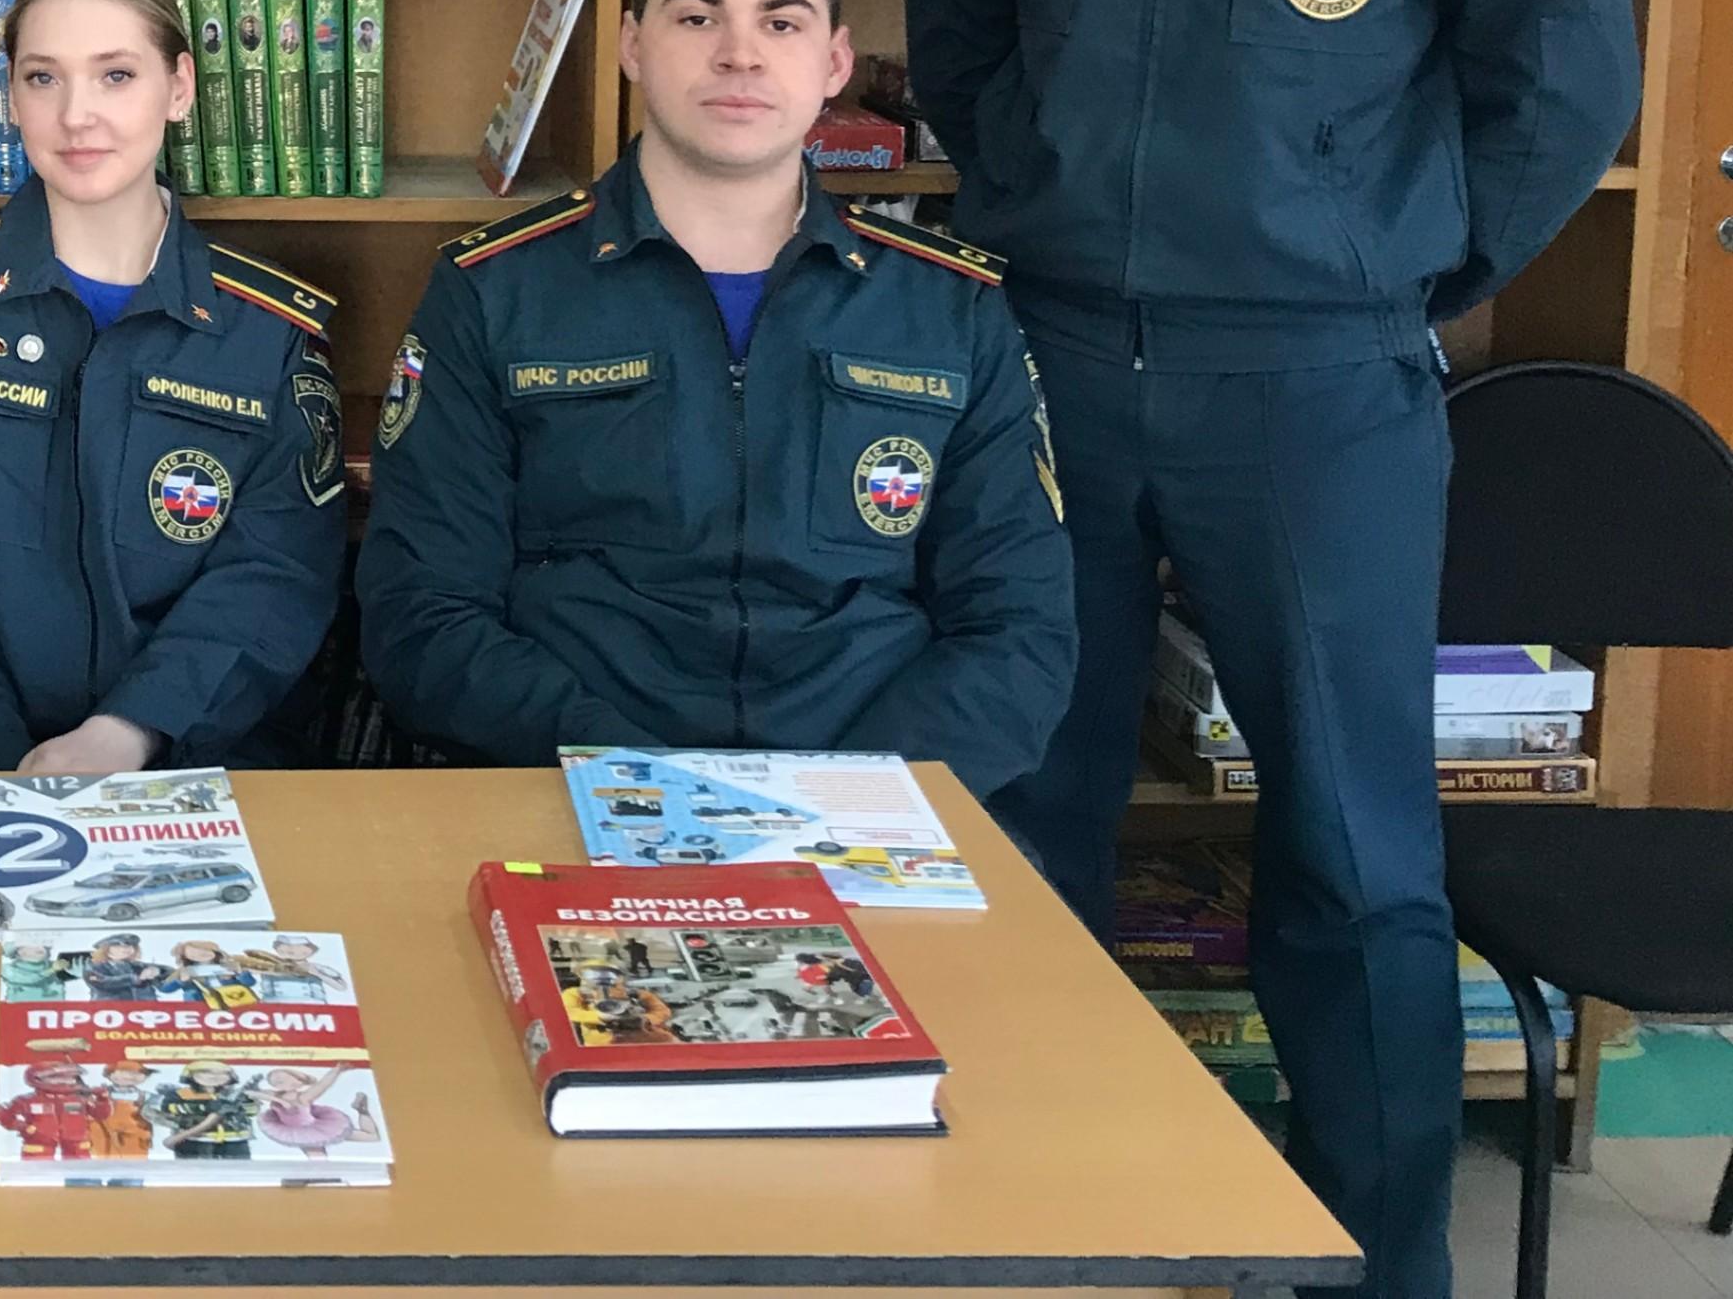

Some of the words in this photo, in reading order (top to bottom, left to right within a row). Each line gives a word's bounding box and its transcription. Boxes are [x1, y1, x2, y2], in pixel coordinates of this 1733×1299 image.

[516, 365, 558, 390] МЧС
[566, 359, 649, 387] РОССИИ
[236, 397, 267, 420] Е.П.
[858, 446, 884, 477] МЧС
[153, 455, 179, 484] МЧС
[186, 452, 231, 500] РОССИИ
[153, 497, 228, 539] EMERCOM
[31, 775, 82, 792] 112
[87, 819, 242, 844] ПОЛИЦИЯ
[610, 897, 747, 910] ЛИЧНАЯ
[556, 908, 812, 923] БЕЗОПАСНОСТЬ
[27, 1009, 336, 1032] ПРОФЕССИИ
[94, 1030, 205, 1041] БОЛЬШАЯ
[212, 1031, 283, 1042] КНИГА
